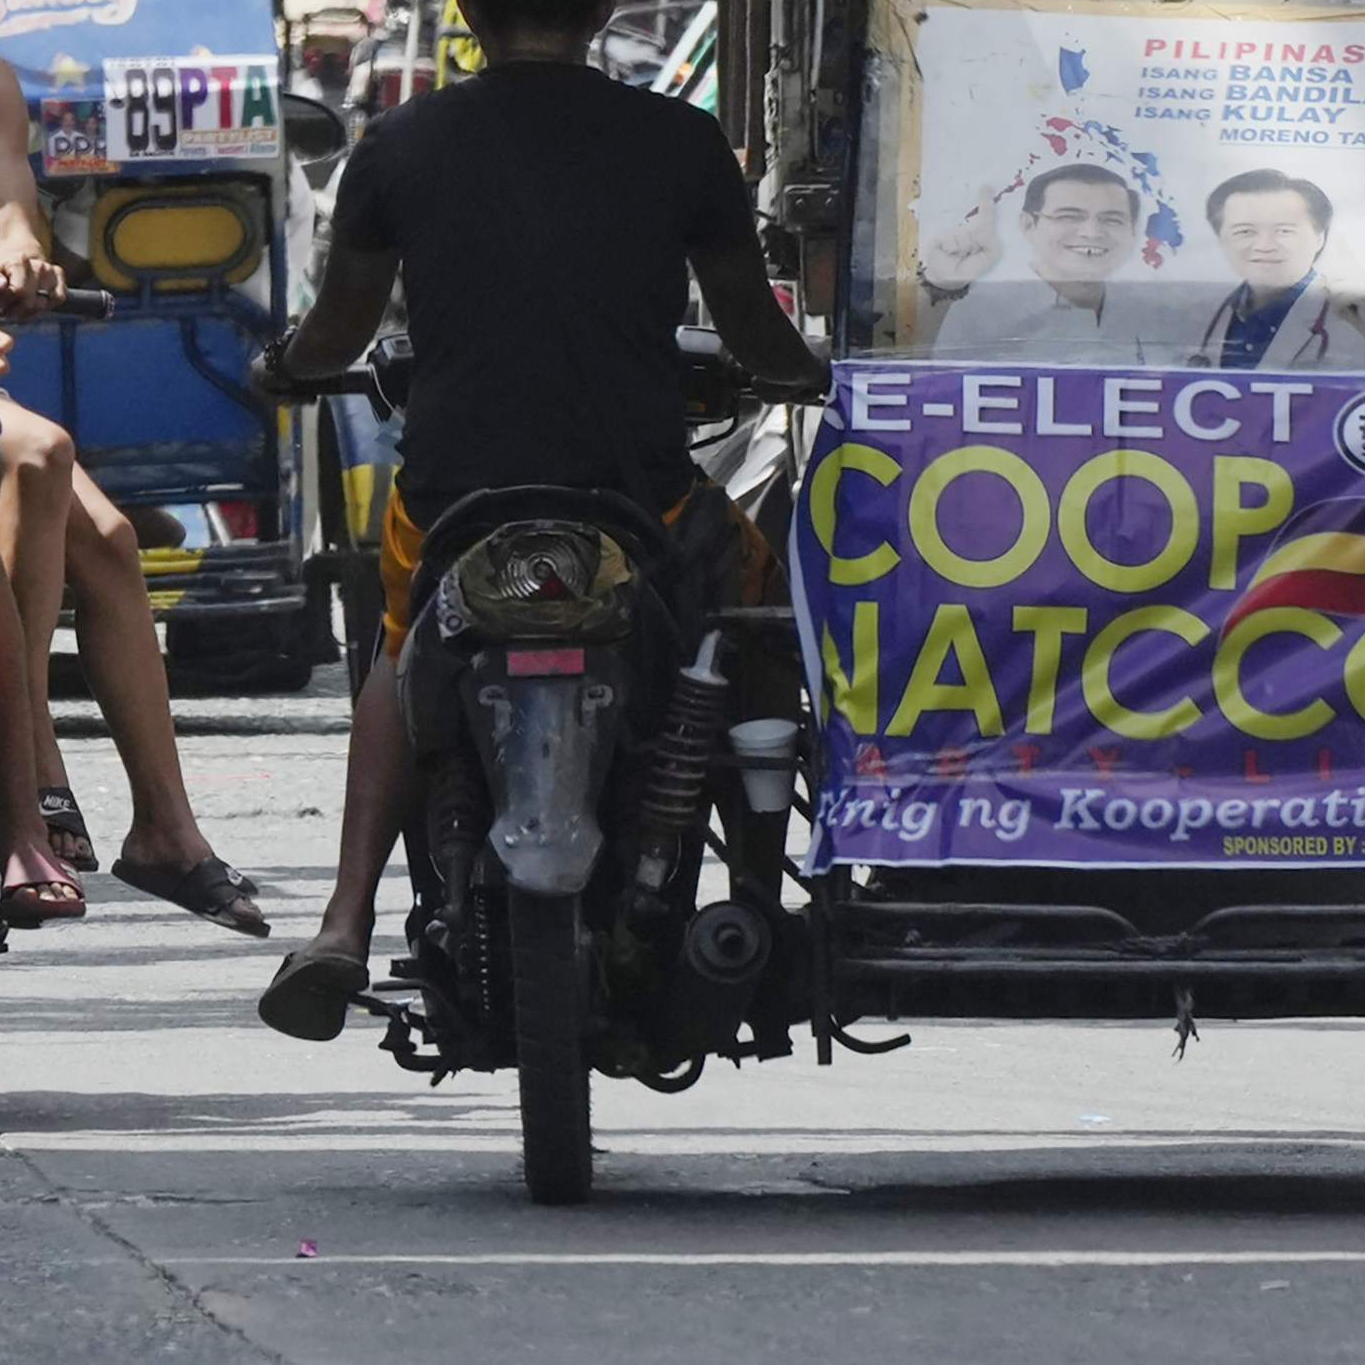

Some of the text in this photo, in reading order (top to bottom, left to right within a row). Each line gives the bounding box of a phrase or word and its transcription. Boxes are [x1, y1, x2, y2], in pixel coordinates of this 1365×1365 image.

[1140, 64, 1355, 85] ISANG BANSA
[177, 64, 276, 130] PTA
[1137, 86, 1216, 101] ISANG
[1133, 104, 1348, 125] ISANG KULAY
[1218, 127, 1331, 145] MORENO
[825, 371, 1315, 444] E-ELECT
[808, 442, 1297, 595] COOP
[43, 794, 72, 809] NIKE
[958, 796, 1032, 843] ng
[1223, 836, 1327, 856] SPONSORED
[1333, 836, 1357, 855] BY
